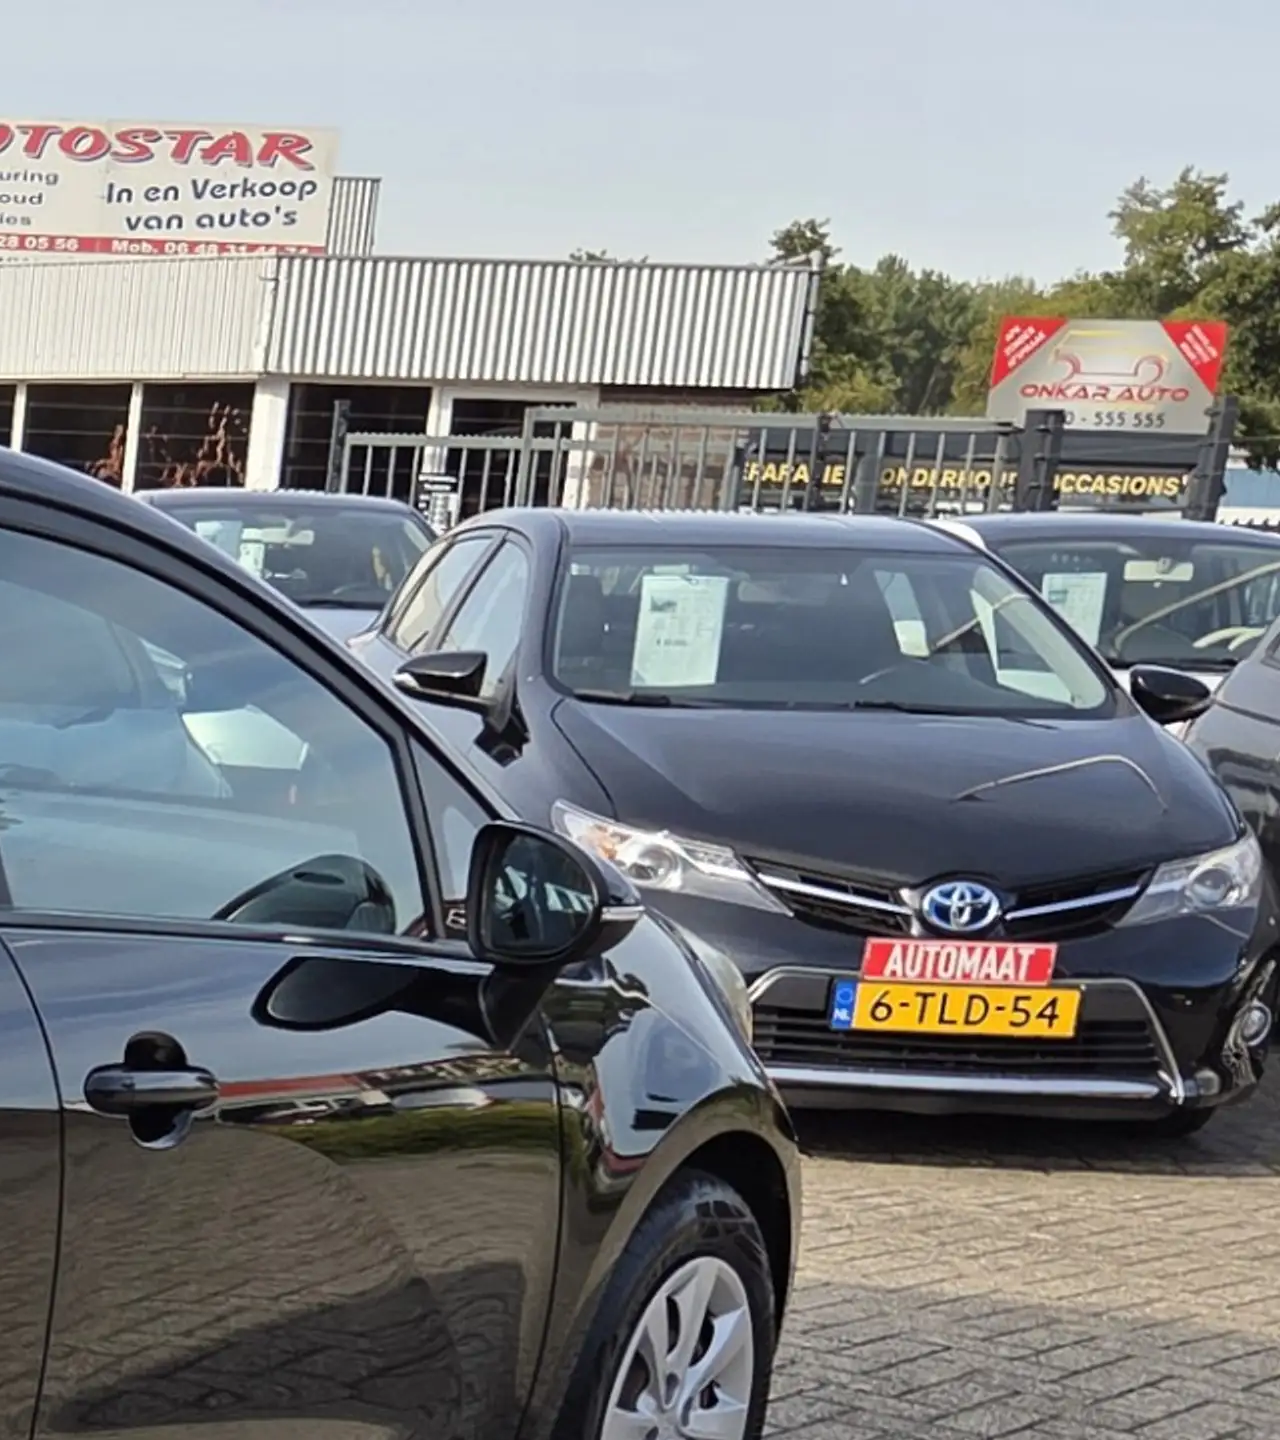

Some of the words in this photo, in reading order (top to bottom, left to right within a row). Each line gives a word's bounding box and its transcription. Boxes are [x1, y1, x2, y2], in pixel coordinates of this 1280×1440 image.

[107, 183, 133, 203] In
[144, 185, 179, 201] en
[191, 177, 317, 201] Verkoop
[126, 214, 183, 231] van
[196, 207, 298, 229] auto's
[24, 236, 48, 249] 05
[54, 238, 78, 250] 56
[112, 240, 157, 254] Mob.
[1020, 384, 1110, 401] ONKAR
[1116, 385, 1189, 402] AUTO
[1095, 411, 1126, 426] 555
[1131, 412, 1165, 428] 555
[1054, 473, 1180, 496] CCASIONS
[883, 943, 1034, 982] AUTOMAAT
[833, 1008, 849, 1021] NL
[870, 990, 1059, 1029] 6-TLD-54
